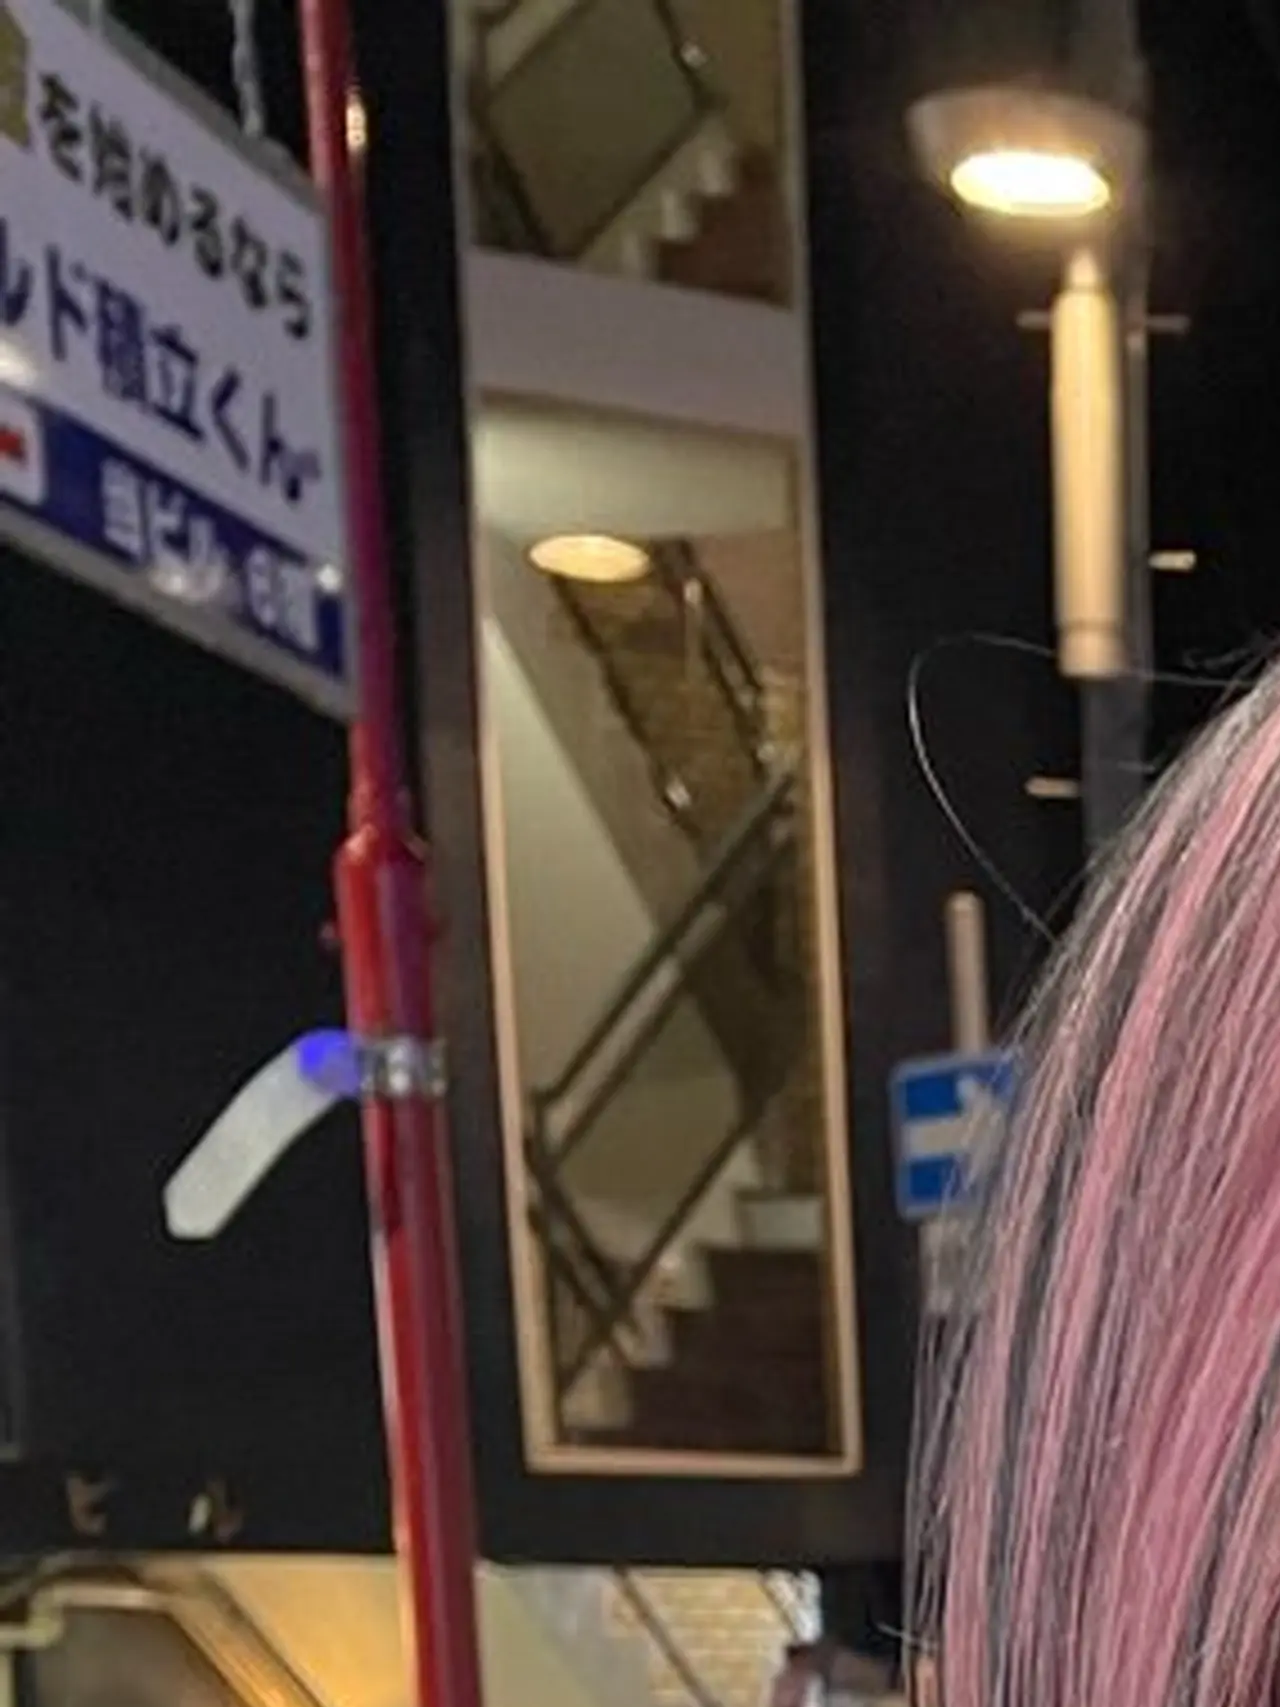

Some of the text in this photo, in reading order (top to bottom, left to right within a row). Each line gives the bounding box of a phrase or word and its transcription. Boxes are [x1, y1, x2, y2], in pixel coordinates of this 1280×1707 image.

[40, 71, 309, 341] を始めるなら
